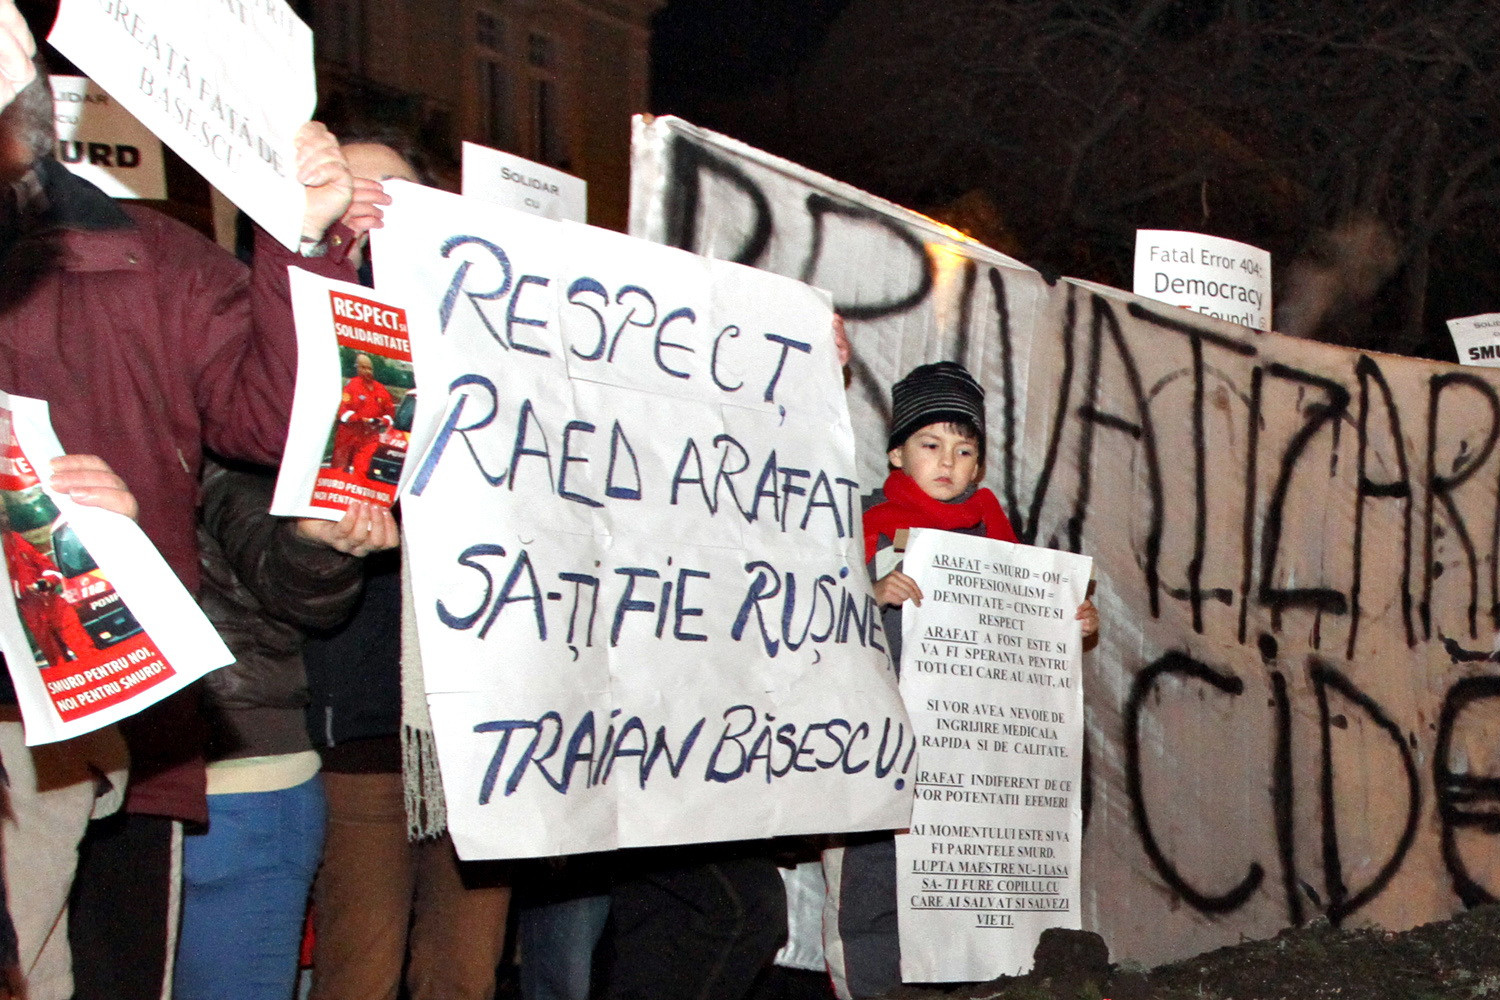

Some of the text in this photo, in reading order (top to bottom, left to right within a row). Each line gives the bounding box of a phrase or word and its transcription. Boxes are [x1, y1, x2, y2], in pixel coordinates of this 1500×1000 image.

[501, 167, 559, 195] SOLIDAR
[1150, 246, 1263, 277] Fatal Error 404:
[1154, 272, 1263, 310] Democracy
[333, 296, 399, 331] RESPECT
[335, 322, 410, 353] SOLIDARITATE
[410, 374, 861, 540] RAED ARAFAT
[933, 554, 981, 570] ARAFAT
[993, 563, 1029, 580] SMURD
[1042, 572, 1060, 584] OM
[948, 574, 1045, 600] PROFESIONALISM
[934, 590, 1004, 610] DEMNITATE
[1014, 602, 1051, 618] CINSTE
[1053, 609, 1063, 619] SI
[979, 614, 1025, 631] RESPECT
[924, 626, 1066, 654] ARAFAT A FOST ESTE SI
[921, 643, 1068, 671] VA FI SPERANTA PENTRU
[47, 674, 87, 695] SMURD
[84, 657, 129, 683] PENTRU
[56, 660, 167, 712] NOI PENTRU SMURD!
[915, 660, 946, 674] TOTI
[951, 665, 972, 676] CEI
[976, 669, 1007, 680] CARE
[1011, 671, 1023, 682] AU
[1058, 677, 1071, 688] AU
[927, 700, 1064, 723] SI VOR AVEA NEVOIE DE
[937, 719, 1057, 740] INGRIJIRE MEDICALA
[473, 706, 706, 806] TRAIAN
[922, 735, 1068, 757] RAPIDA SI DE CALITATE.
[971, 775, 1039, 789] INDIFERENT
[1045, 780, 1057, 791] DE
[1060, 781, 1072, 791] CE
[914, 789, 1068, 808] VOR POTENTATII EFEMERI
[912, 825, 1069, 842] AI MOMENTULUI ESTE SI VA
[932, 843, 1055, 858] FI PARINTELE SMURD.
[912, 860, 954, 872] LUPTA
[959, 862, 1014, 874] MAESTRE
[1044, 865, 1068, 876] LASA
[962, 880, 993, 891] FURE
[997, 880, 1044, 892] COPILUL
[1046, 882, 1059, 893] CU
[911, 896, 1069, 909] CARE AI SALVAT SI SALVEZI
[976, 914, 1014, 926] VIETI.
